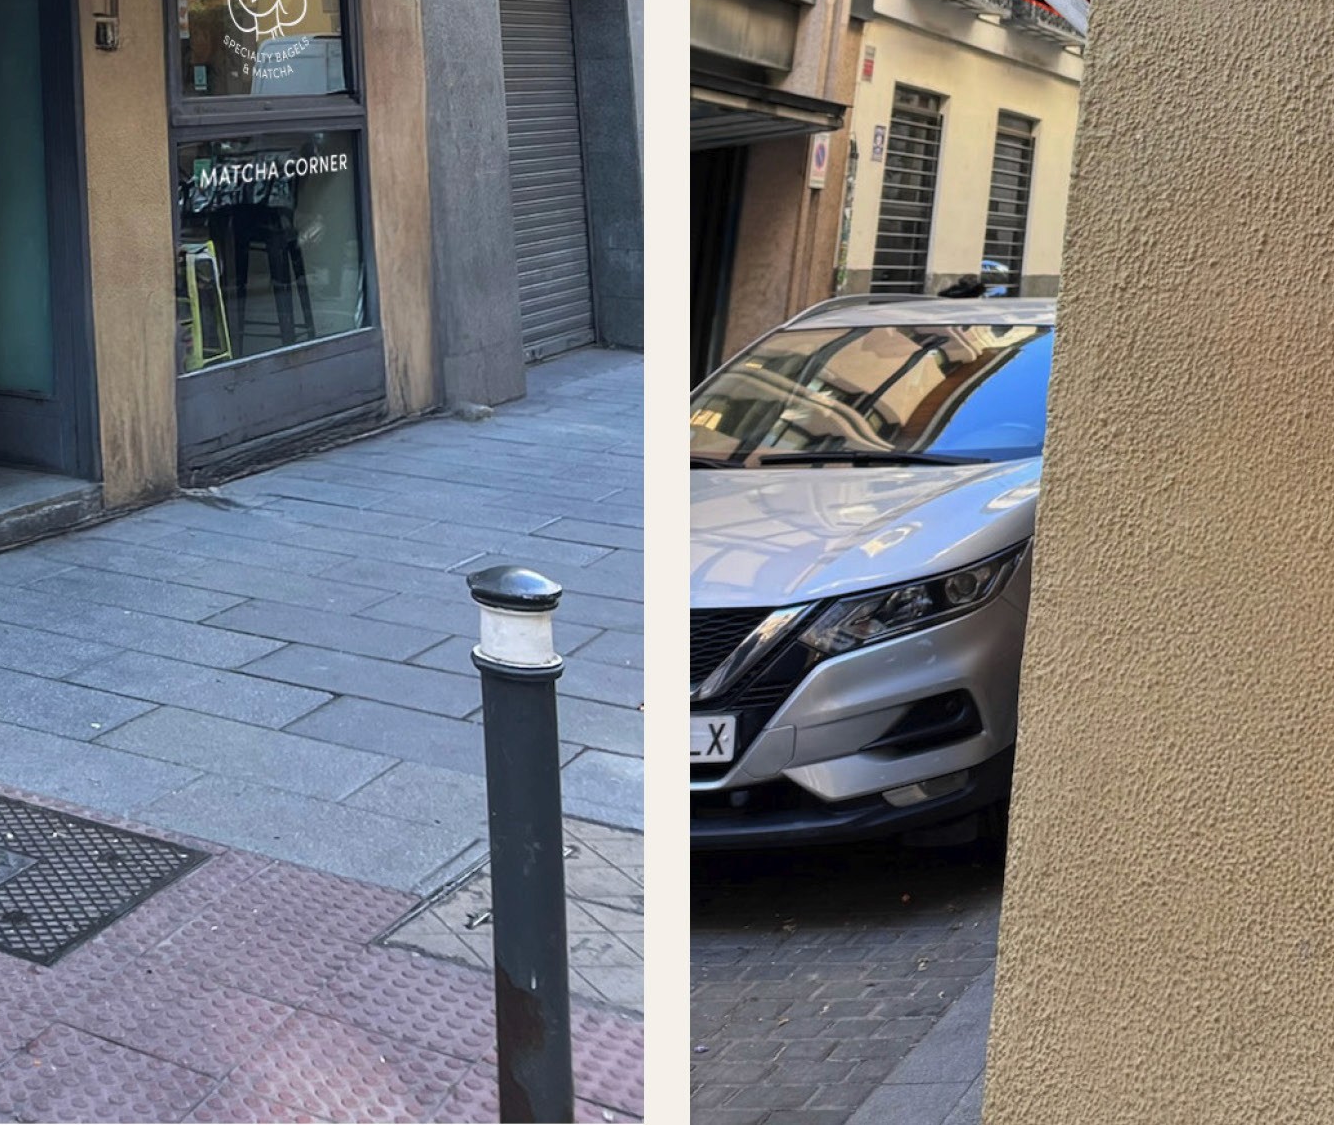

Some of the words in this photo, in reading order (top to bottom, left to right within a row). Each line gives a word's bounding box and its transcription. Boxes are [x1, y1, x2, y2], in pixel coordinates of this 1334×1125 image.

[223, 35, 273, 63] SPECIALTY
[276, 36, 310, 62] BAGELS
[243, 63, 249, 75] &
[252, 64, 294, 80] MATCHA
[200, 161, 279, 189] MATCHA
[284, 153, 347, 178] CORNER
